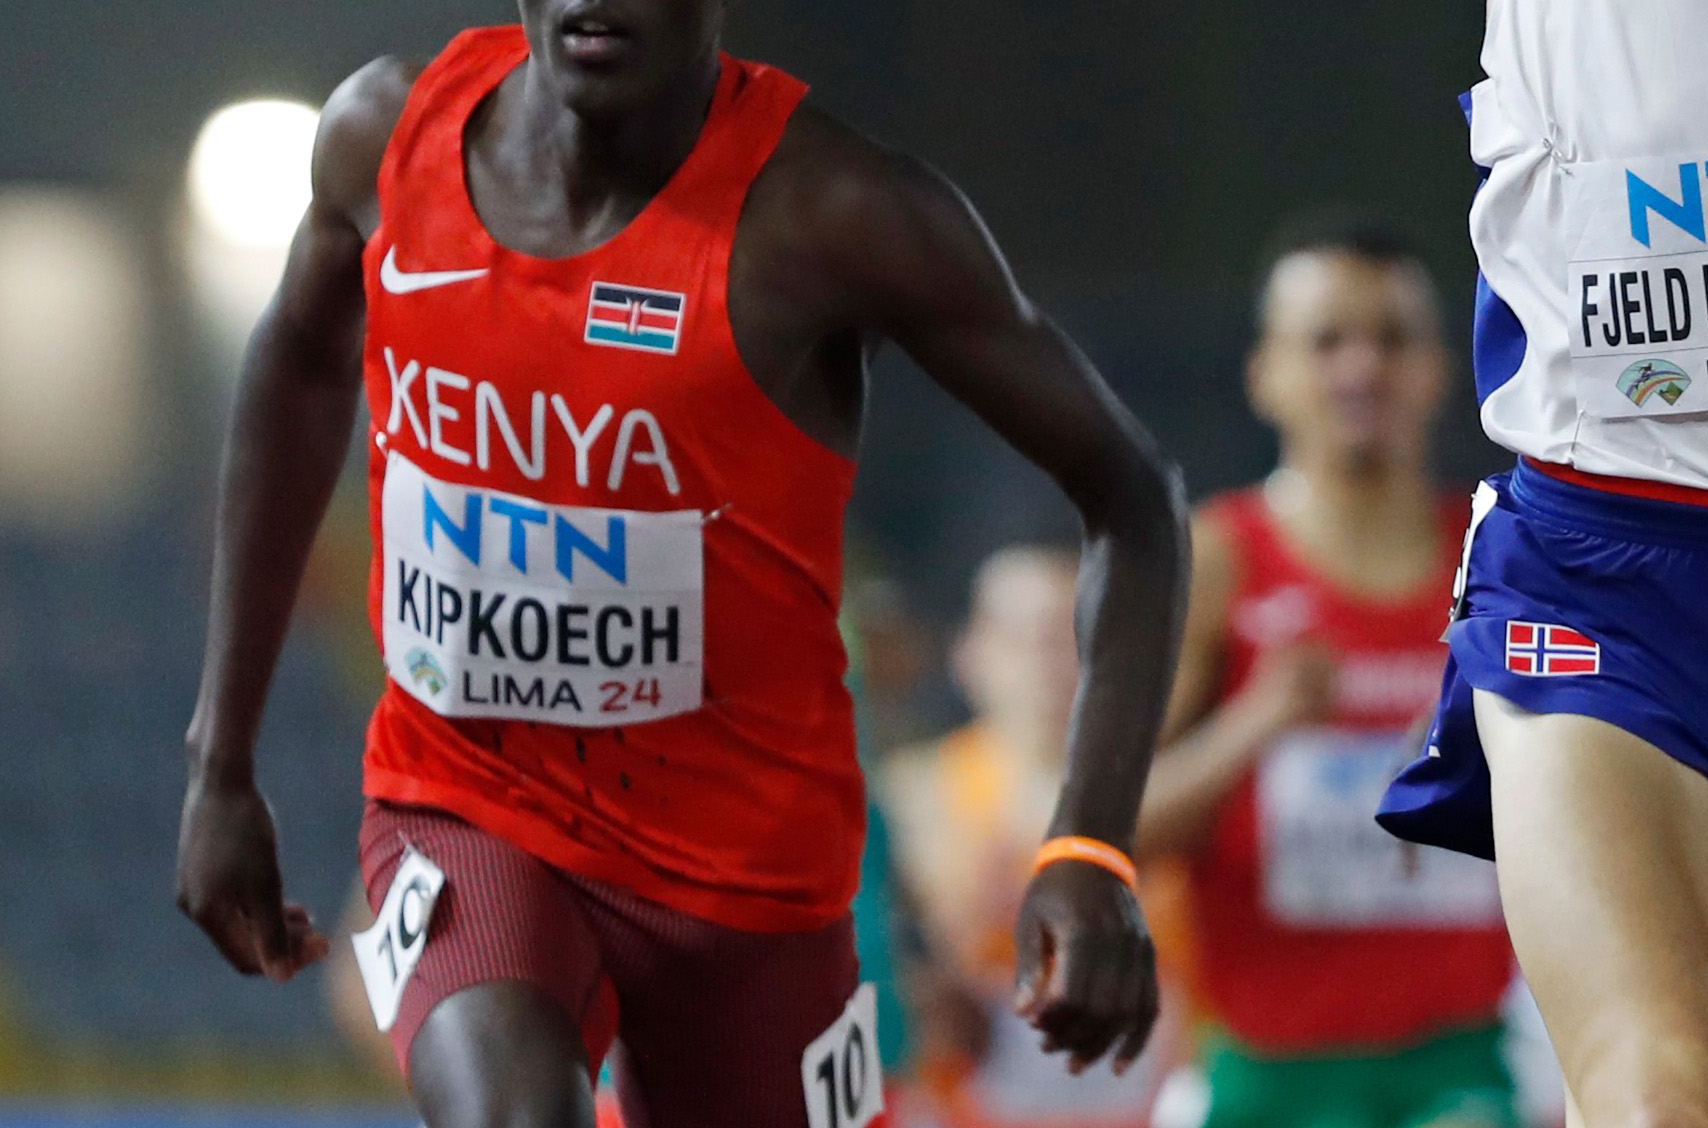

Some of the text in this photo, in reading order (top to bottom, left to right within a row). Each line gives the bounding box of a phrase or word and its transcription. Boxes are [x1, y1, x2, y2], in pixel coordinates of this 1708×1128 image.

[1581, 267, 1692, 348] FJELD
[383, 346, 680, 495] KENYA
[423, 481, 627, 585] NTN
[397, 559, 680, 670] KIPKOECH
[461, 669, 662, 713] LIMA 24
[816, 1021, 865, 1128] 10
